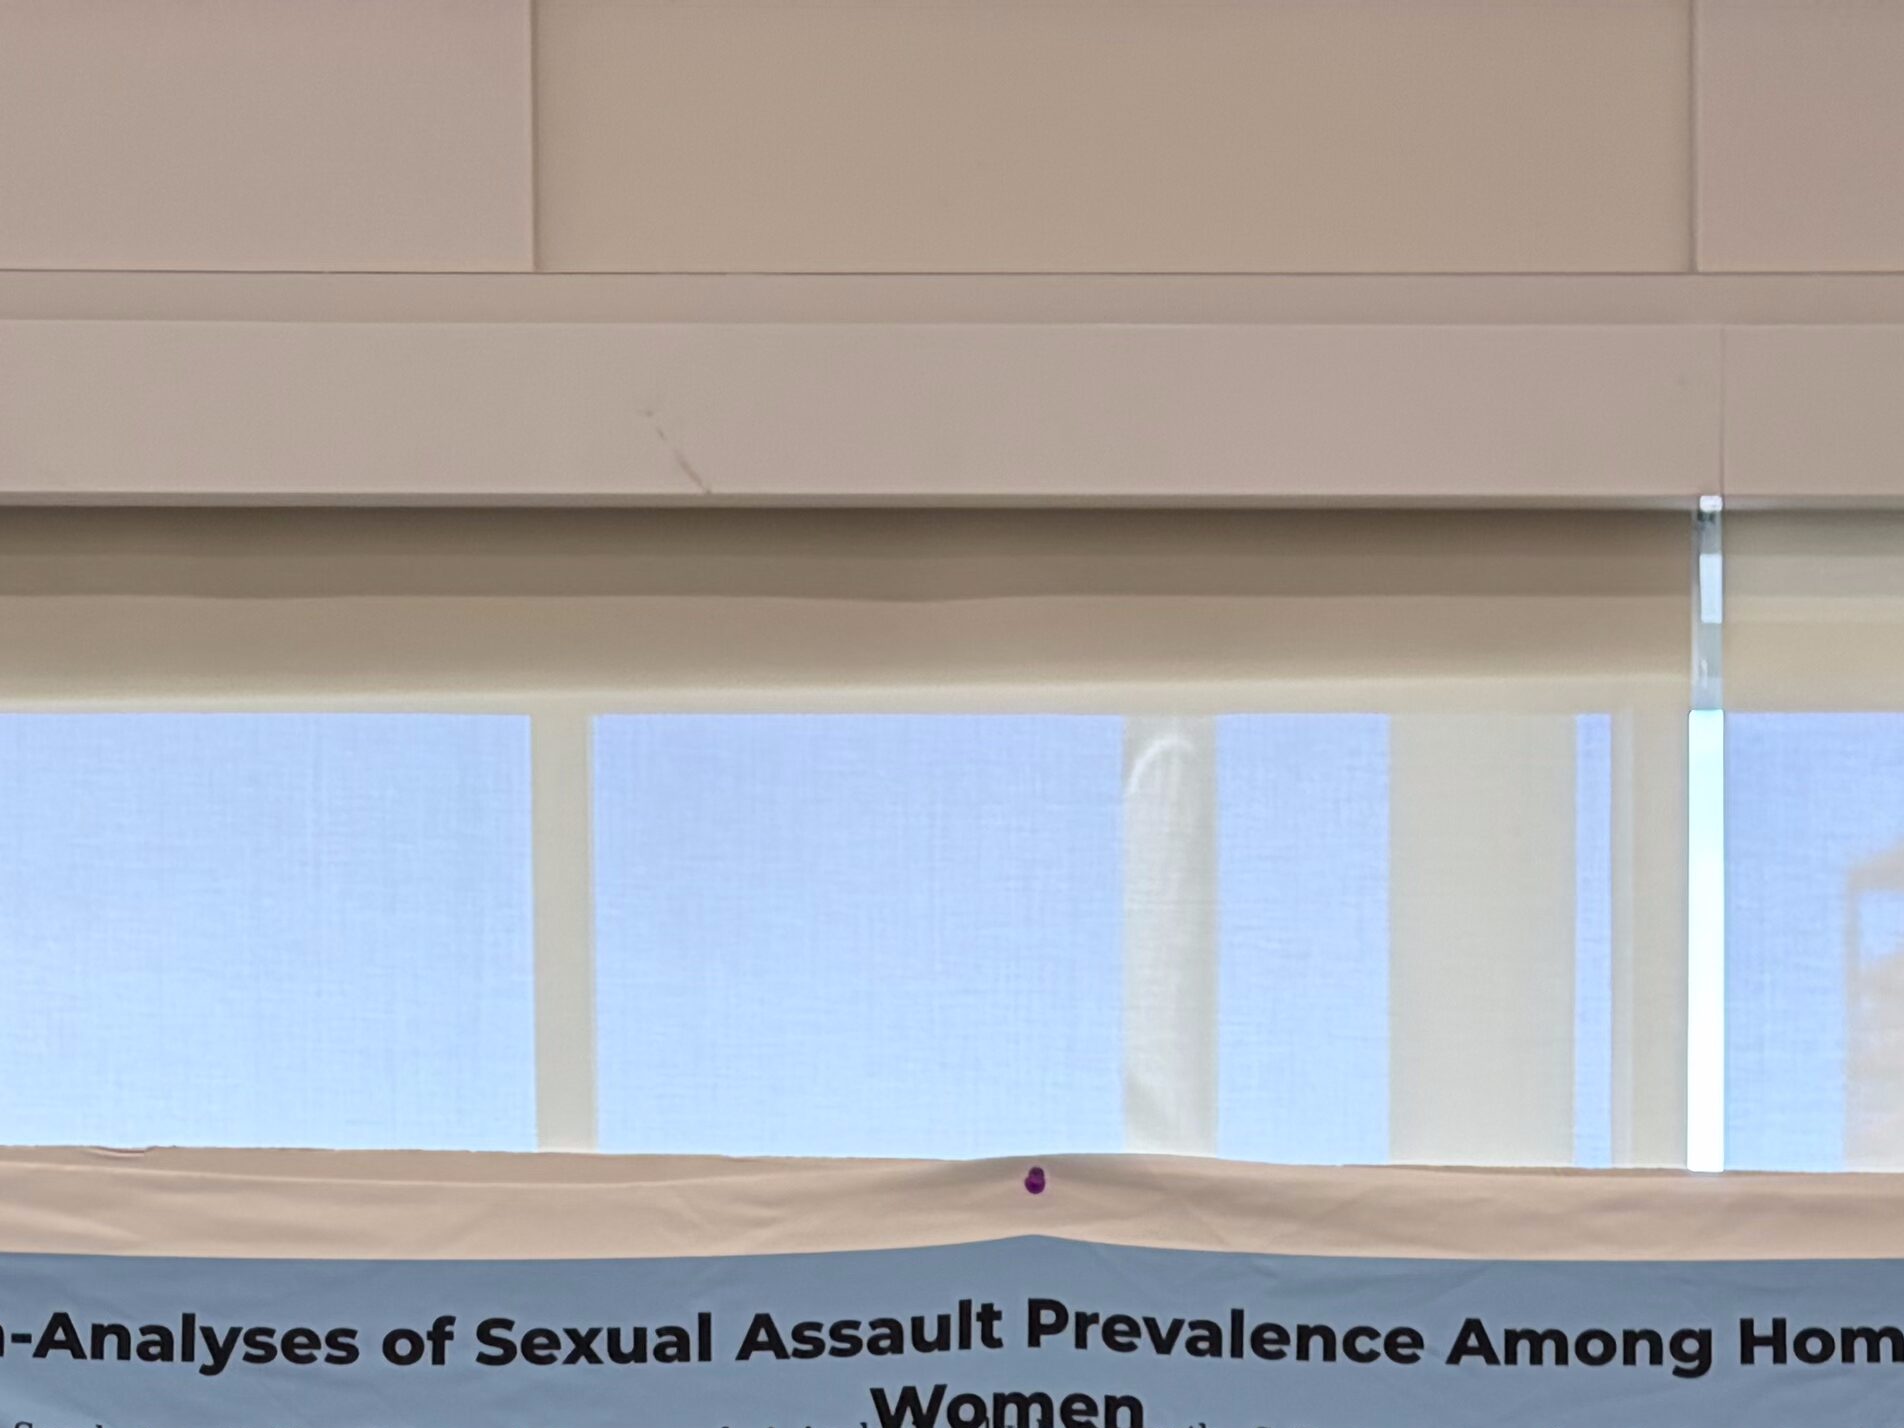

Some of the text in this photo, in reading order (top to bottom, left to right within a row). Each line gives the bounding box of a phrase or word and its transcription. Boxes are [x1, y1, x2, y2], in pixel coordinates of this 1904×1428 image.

[381, 1314, 457, 1367] of
[475, 1311, 713, 1367] Sexual
[734, 1298, 1004, 1362] Assault
[1027, 1297, 1425, 1366] Prevalence
[1444, 1316, 1713, 1380] Among
